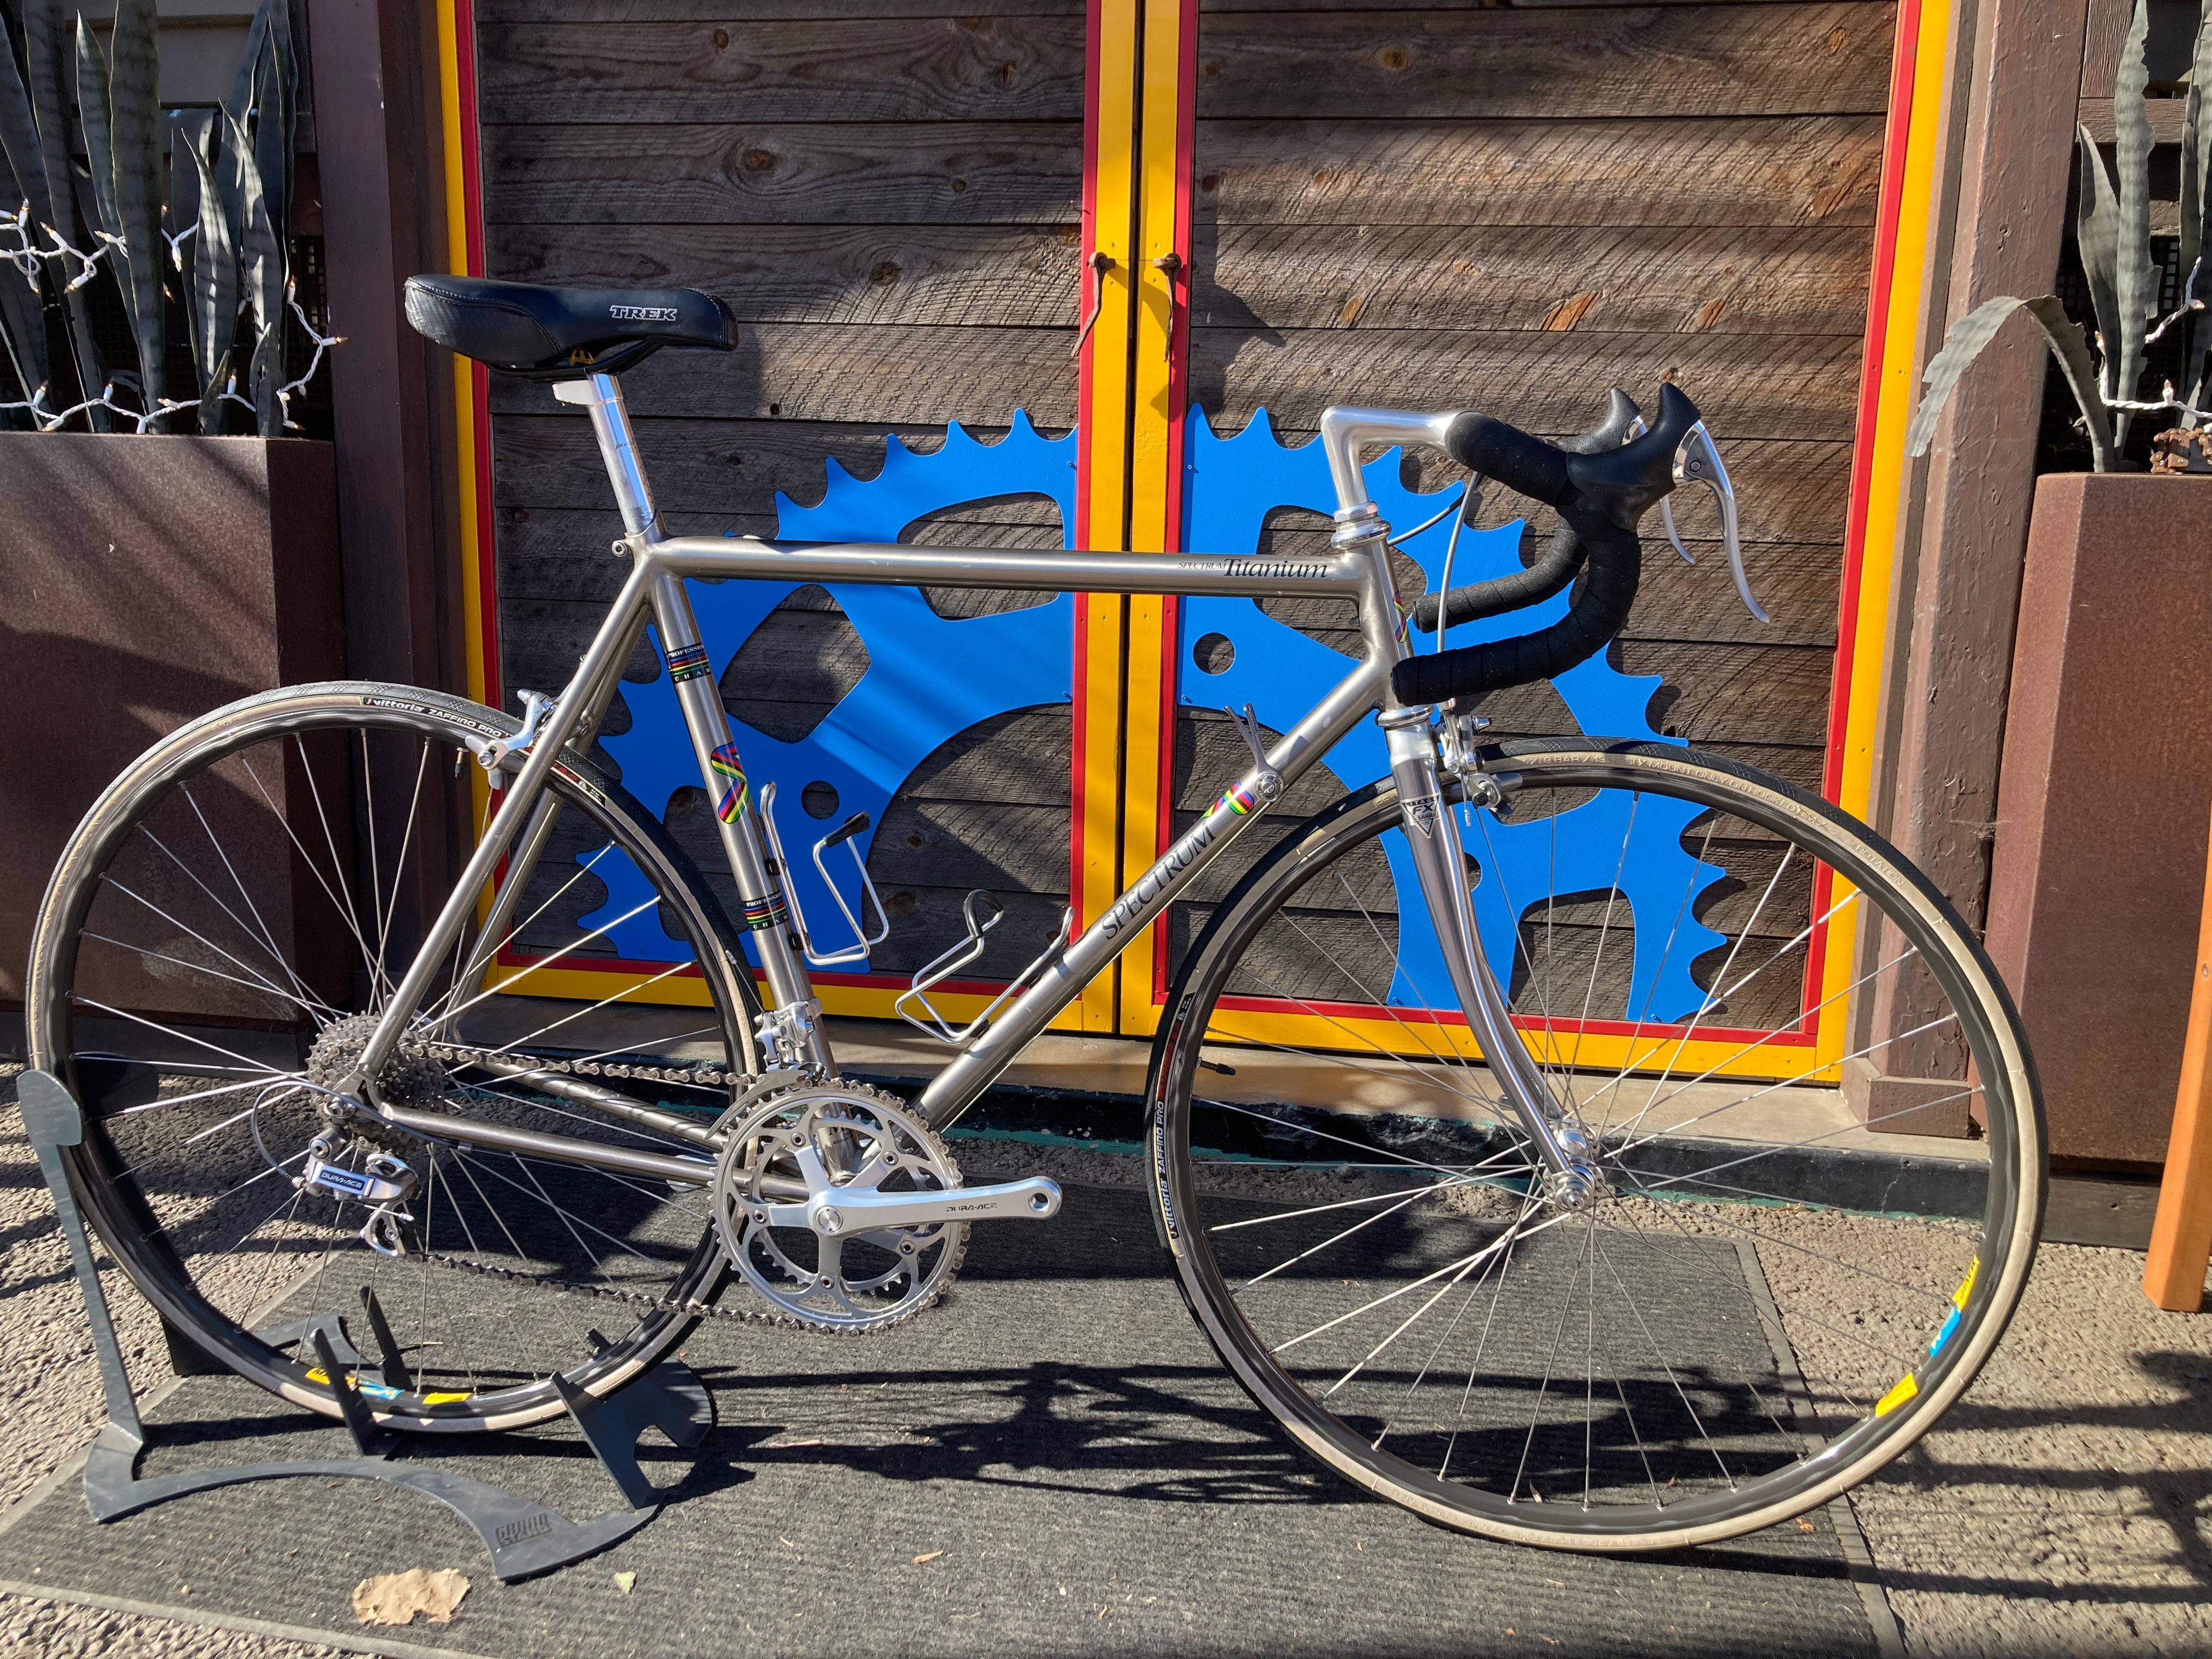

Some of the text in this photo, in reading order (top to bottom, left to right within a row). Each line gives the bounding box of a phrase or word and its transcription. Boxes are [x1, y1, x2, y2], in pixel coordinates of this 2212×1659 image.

[610, 304, 678, 321] TREK
[1178, 558, 1328, 578] SPECTRUM Titanium
[373, 699, 502, 737] vittoria ZAFFIRO PRO
[1649, 760, 1692, 775] MOUNT
[1695, 770, 1729, 784] ONLY
[1729, 780, 1748, 792] ON
[1748, 786, 1796, 812] HOOKED
[1413, 803, 1435, 815] FX
[1417, 812, 1437, 821] SAKAE
[1102, 823, 1217, 941] SPECTRUM
[1156, 1126, 1166, 1174] ZAFFIRO
[320, 1172, 363, 1188] DURA-ACE
[946, 1203, 998, 1212] DURA-ACE
[1160, 1180, 1176, 1229] vittoria
